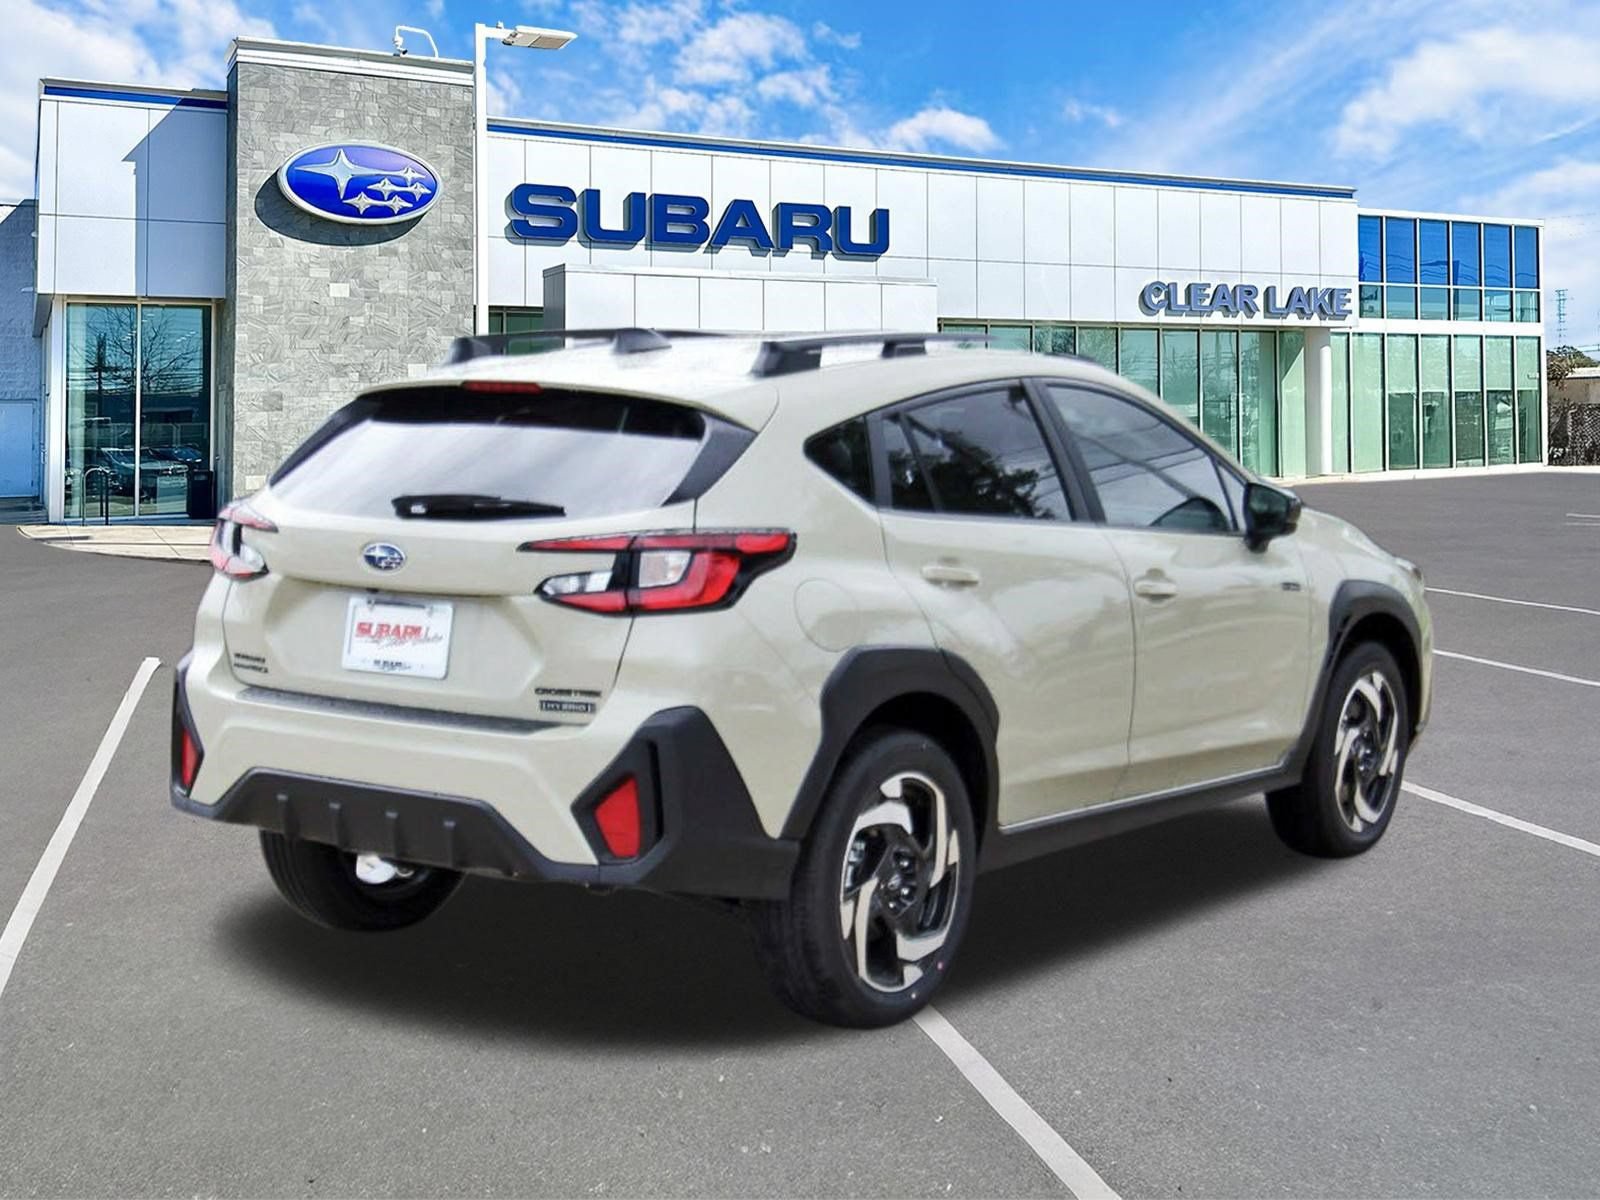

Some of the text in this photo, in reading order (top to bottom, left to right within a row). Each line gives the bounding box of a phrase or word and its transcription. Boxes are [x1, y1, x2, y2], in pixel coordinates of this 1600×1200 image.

[506, 183, 890, 258] SUBARU
[1140, 281, 1353, 319] CLEAR LAKE
